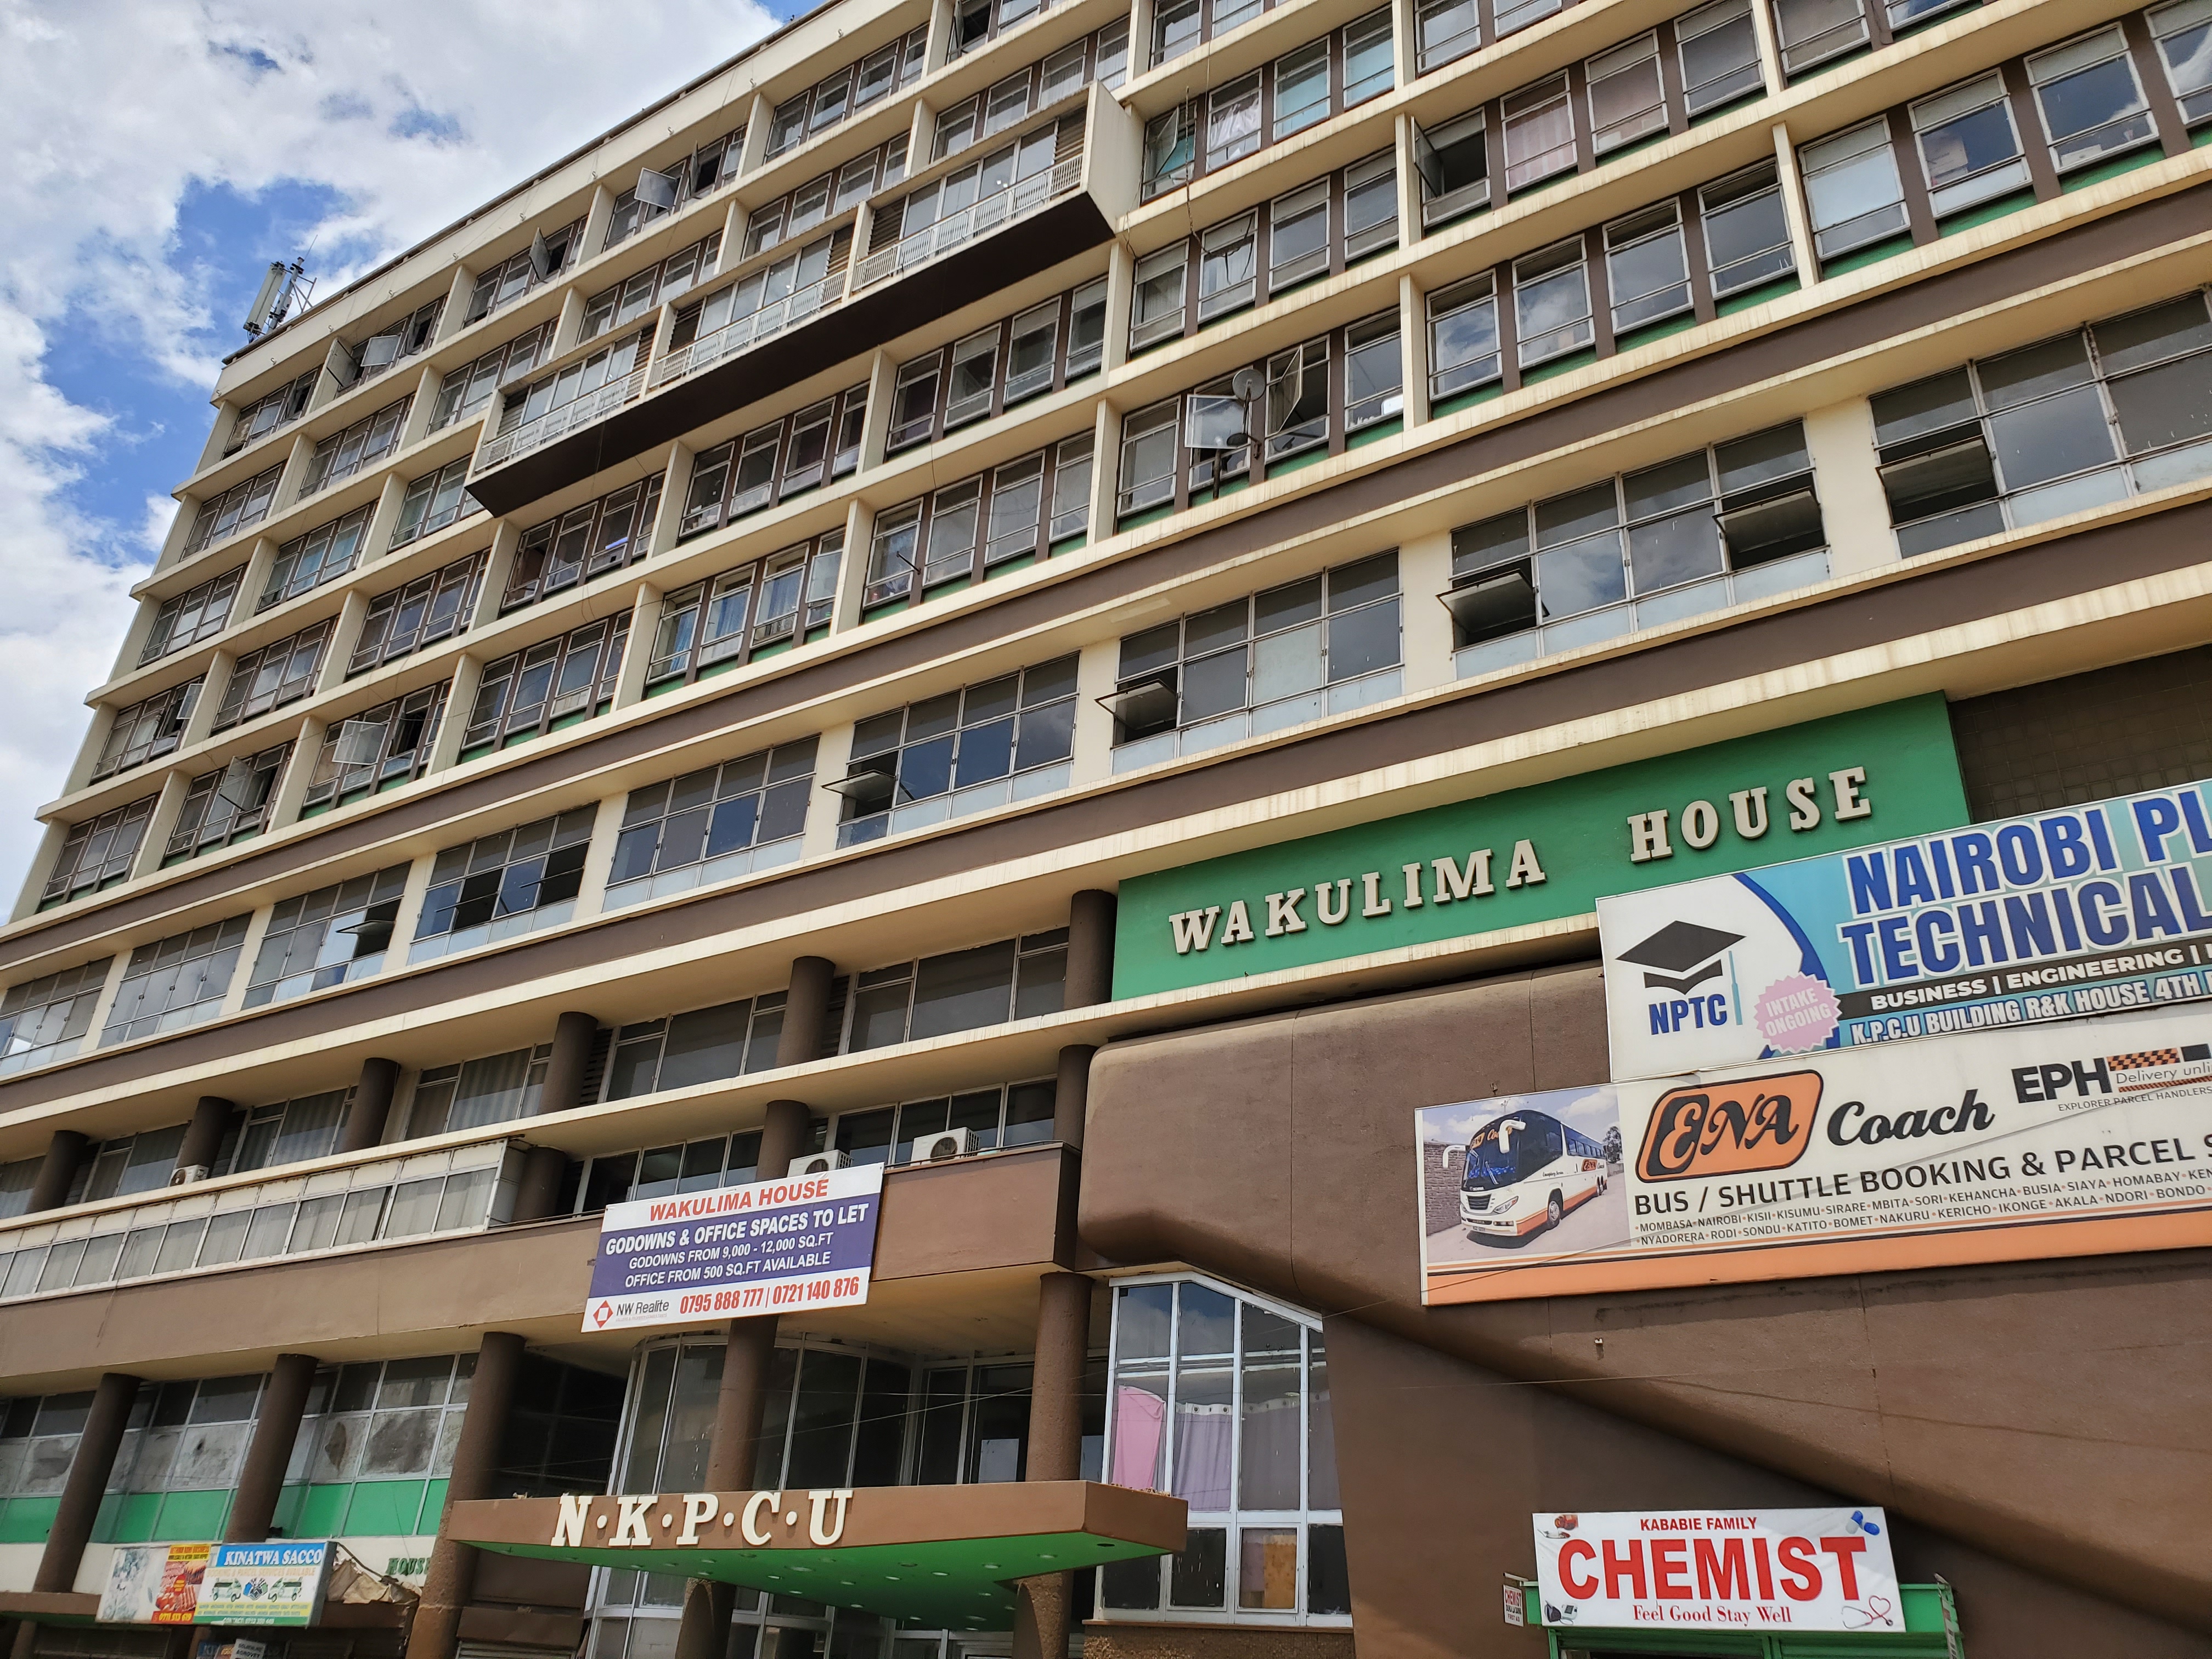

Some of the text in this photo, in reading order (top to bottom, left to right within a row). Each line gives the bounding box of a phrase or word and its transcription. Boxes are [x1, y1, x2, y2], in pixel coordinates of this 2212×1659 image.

[1169, 766, 1872, 955] WAKULIMA HOUSE
[1846, 790, 2212, 916] NAIROBI PL
[1841, 866, 2212, 985] TECHNICAL
[1870, 979, 1987, 1011] BUSINESS
[2006, 949, 2185, 989] ENGINEERING
[1649, 993, 1728, 1036] NPTC
[1765, 988, 1819, 1017] INTAKE
[1765, 1003, 1832, 1036] ONGOING
[1852, 1018, 1921, 1045] K.P.C.U
[1926, 1001, 2021, 1034] BUILDING
[2024, 992, 2072, 1019] R&K
[2074, 981, 2151, 1012] HOUSE
[2155, 973, 2202, 1000] 4TH
[2011, 1057, 2113, 1103] EPH
[2116, 1068, 2177, 1084] Delivery
[2058, 1086, 2212, 1111] EXPLORER PARCEL HANDLERS
[1646, 1088, 1996, 1176] ENA Coach
[1634, 1190, 1689, 1215] BUS
[1718, 1173, 1852, 1208] SHUTTLE
[1860, 1156, 2011, 1193] BOOKING
[2022, 1152, 2046, 1177] &
[2055, 1138, 2196, 1173] PARCEL
[650, 1178, 829, 1222] WAKULIMA HOUSE
[1640, 1219, 1693, 1232] MOMBASA
[1697, 1214, 1742, 1227] NAIROBI
[1747, 1211, 1771, 1222] KISII
[1776, 1206, 1821, 1220] KISUMU
[1826, 1202, 1866, 1215] SIRARE
[1872, 1198, 1909, 1210] MBITA
[1915, 1194, 1943, 1206] SORI
[1949, 1187, 2017, 1203] KEHANCHA
[2023, 1183, 2062, 1195] BUSIA
[2067, 1179, 2107, 1192] SIAYA
[2113, 1171, 2180, 1187] HOMABAY
[1641, 1185, 2205, 1245] NYADORERA RODI SONDU KATITO BOMET NAKURU KERICHO IKONGE AKALA NDORI BONDO
[605, 1203, 870, 1256] GODOWNS & OFFICE SPACES TO LET
[629, 1252, 685, 1269] GODOWNS
[688, 1247, 720, 1262] FROM
[723, 1244, 751, 1260] 9,000
[761, 1239, 795, 1255] 12,000
[798, 1232, 834, 1249] SQ.FT
[625, 1251, 832, 1288] OFFICE FROM 500 SQ.FT AVAILABLE
[617, 1299, 669, 1316] NW Realite
[680, 1293, 712, 1314] 0795
[714, 1290, 740, 1310] 888
[743, 1288, 763, 1307] 777
[772, 1283, 804, 1304] 0721
[806, 1279, 830, 1300] 140
[833, 1276, 859, 1297] 876
[1640, 1516, 1757, 1531] KABABIE FAMILY
[224, 1550, 280, 1566] KINATWA
[282, 1549, 322, 1565] SACCO
[1558, 1536, 1867, 1601] CHEMIST
[1505, 1589, 1521, 1607] CHEMIST
[1633, 1605, 1793, 1627] Feel Good Stay Well
